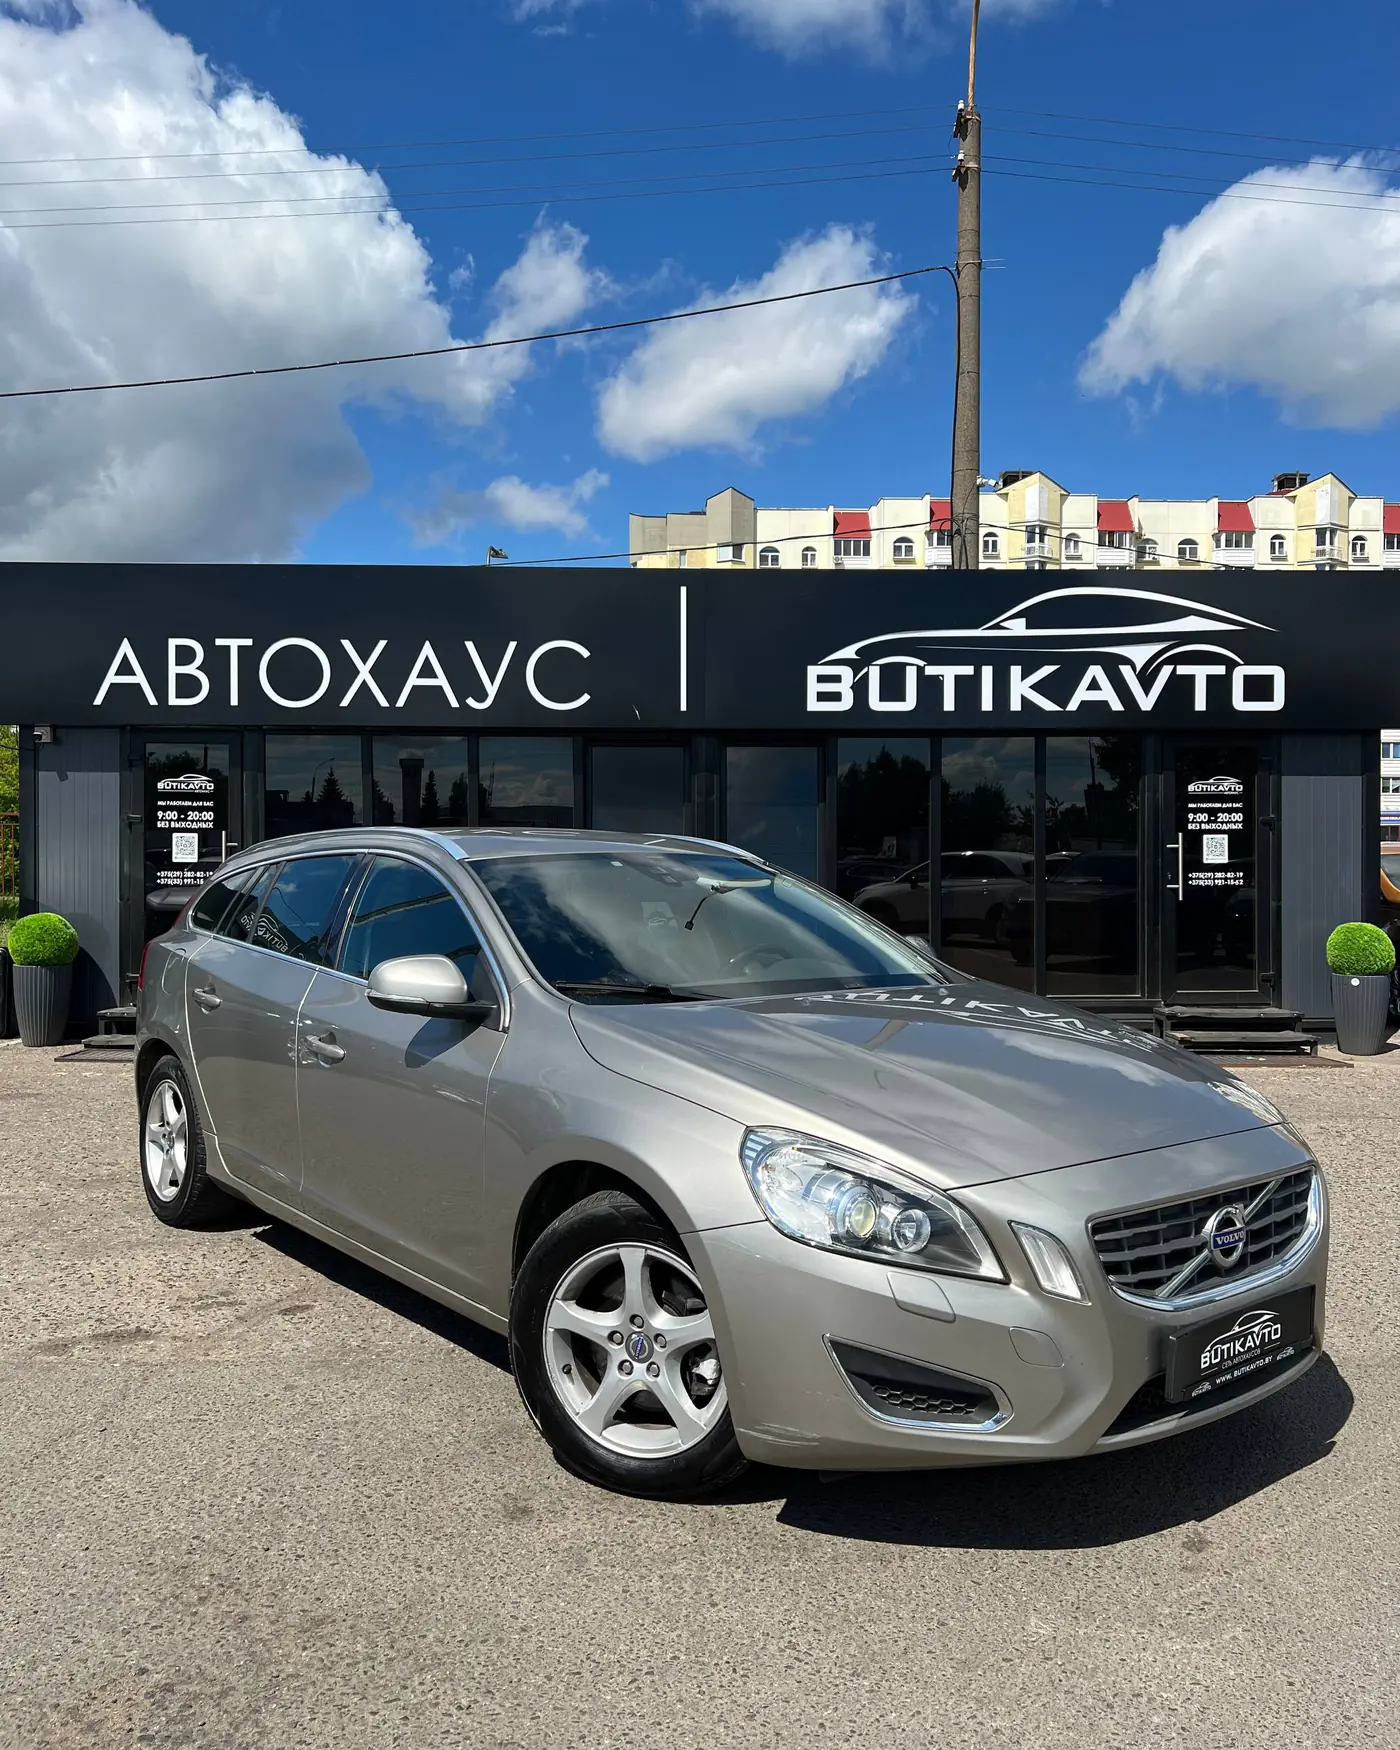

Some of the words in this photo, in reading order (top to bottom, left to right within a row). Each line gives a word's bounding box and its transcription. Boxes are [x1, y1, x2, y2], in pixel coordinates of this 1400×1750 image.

[93, 637, 591, 710] АВТОХАУС
[806, 664, 1286, 712] BUTIKAVTO
[157, 782, 214, 790] BUTIKAVTO
[1187, 784, 1244, 792] BUTIKAVTO
[157, 810, 178, 821] 9:00
[186, 811, 214, 821] 20:00
[1188, 812, 1209, 822] 9:00
[1216, 812, 1243, 822] 20:00
[157, 820, 170, 828] БЕЗ
[170, 821, 214, 829] ВЫХОДНЫХ
[1188, 822, 1201, 830] БЕЗ
[1201, 822, 1243, 831] ВЫХОДНЫХ
[1215, 1230, 1245, 1245] VOLVO
[1200, 1323, 1281, 1369] BUTIKAVTO
[1221, 1360, 1233, 1369] СЕТЬ
